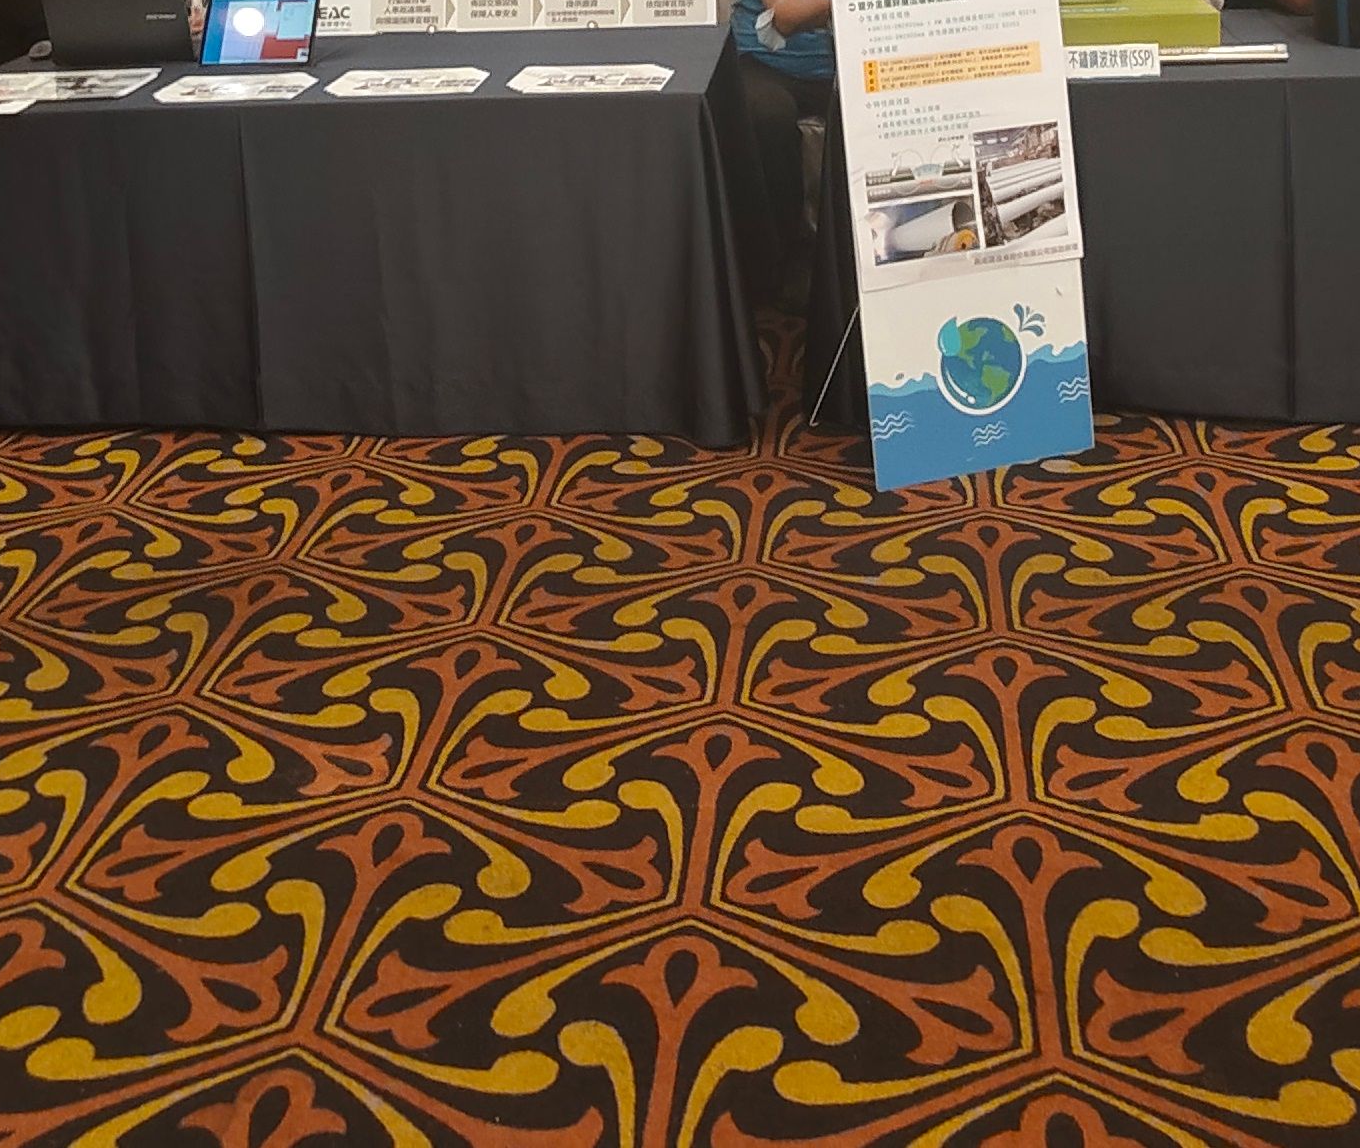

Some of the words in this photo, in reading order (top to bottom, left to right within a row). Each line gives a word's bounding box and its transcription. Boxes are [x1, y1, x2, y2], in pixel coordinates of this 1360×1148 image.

[1068, 49, 1154, 69] 不鏽鋼波狀管(SSP)
